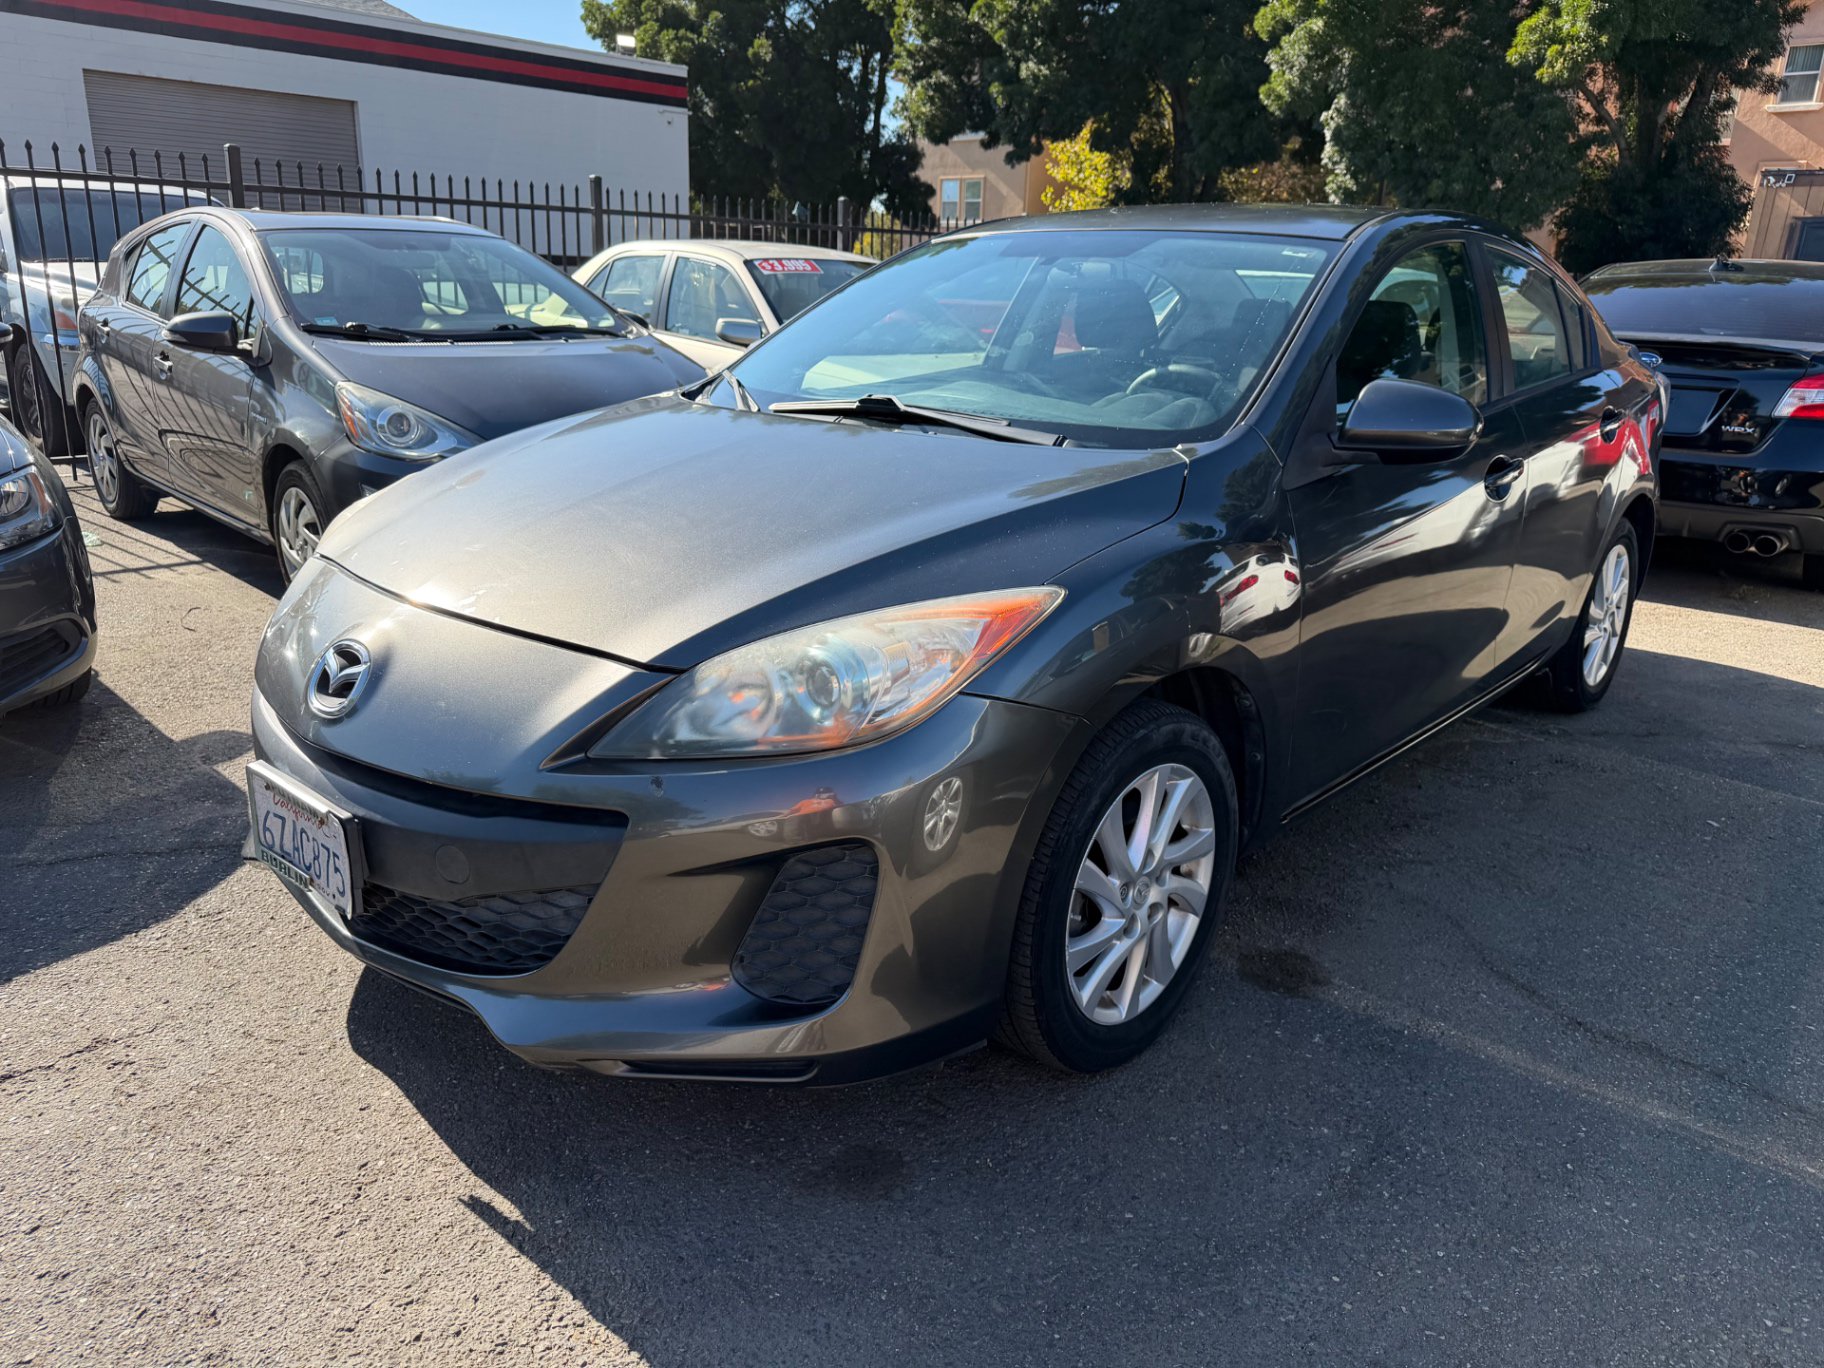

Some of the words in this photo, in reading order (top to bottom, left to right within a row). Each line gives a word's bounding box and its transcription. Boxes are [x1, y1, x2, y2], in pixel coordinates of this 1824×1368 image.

[761, 259, 812, 272] $3,995
[1721, 425, 1755, 433] WRX
[262, 809, 346, 898] 6ZAC875
